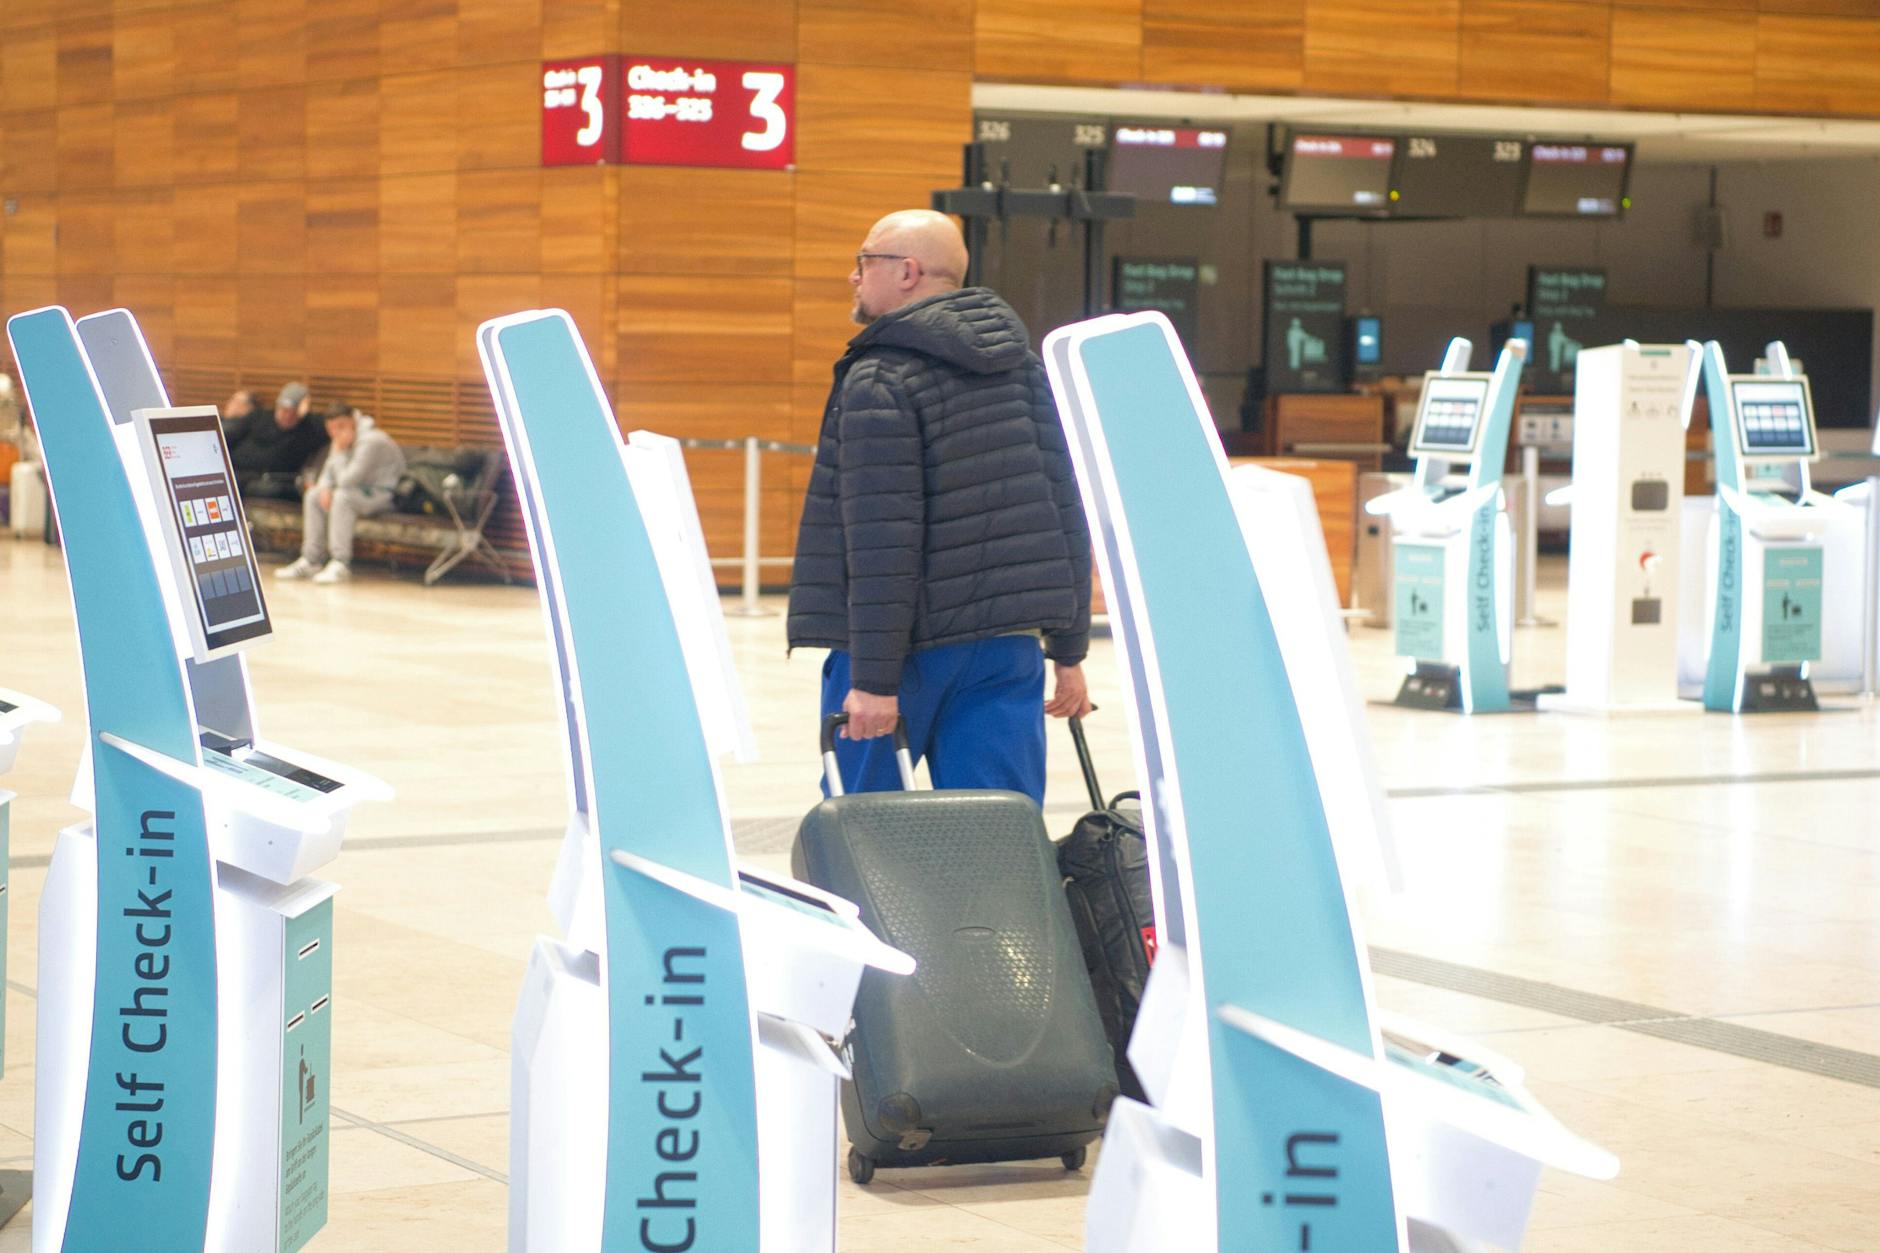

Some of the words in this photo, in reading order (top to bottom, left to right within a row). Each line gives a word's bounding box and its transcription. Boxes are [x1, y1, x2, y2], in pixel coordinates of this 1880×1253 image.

[577, 66, 603, 146] 3
[628, 65, 716, 92] Check-in
[741, 72, 787, 151] 3
[1477, 505, 1490, 589] Check-in
[1476, 595, 1490, 631] Self
[1721, 593, 1733, 632] Self
[119, 809, 176, 1053] Check-in
[115, 1072, 165, 1182] Self
[636, 946, 707, 1253] Check-in
